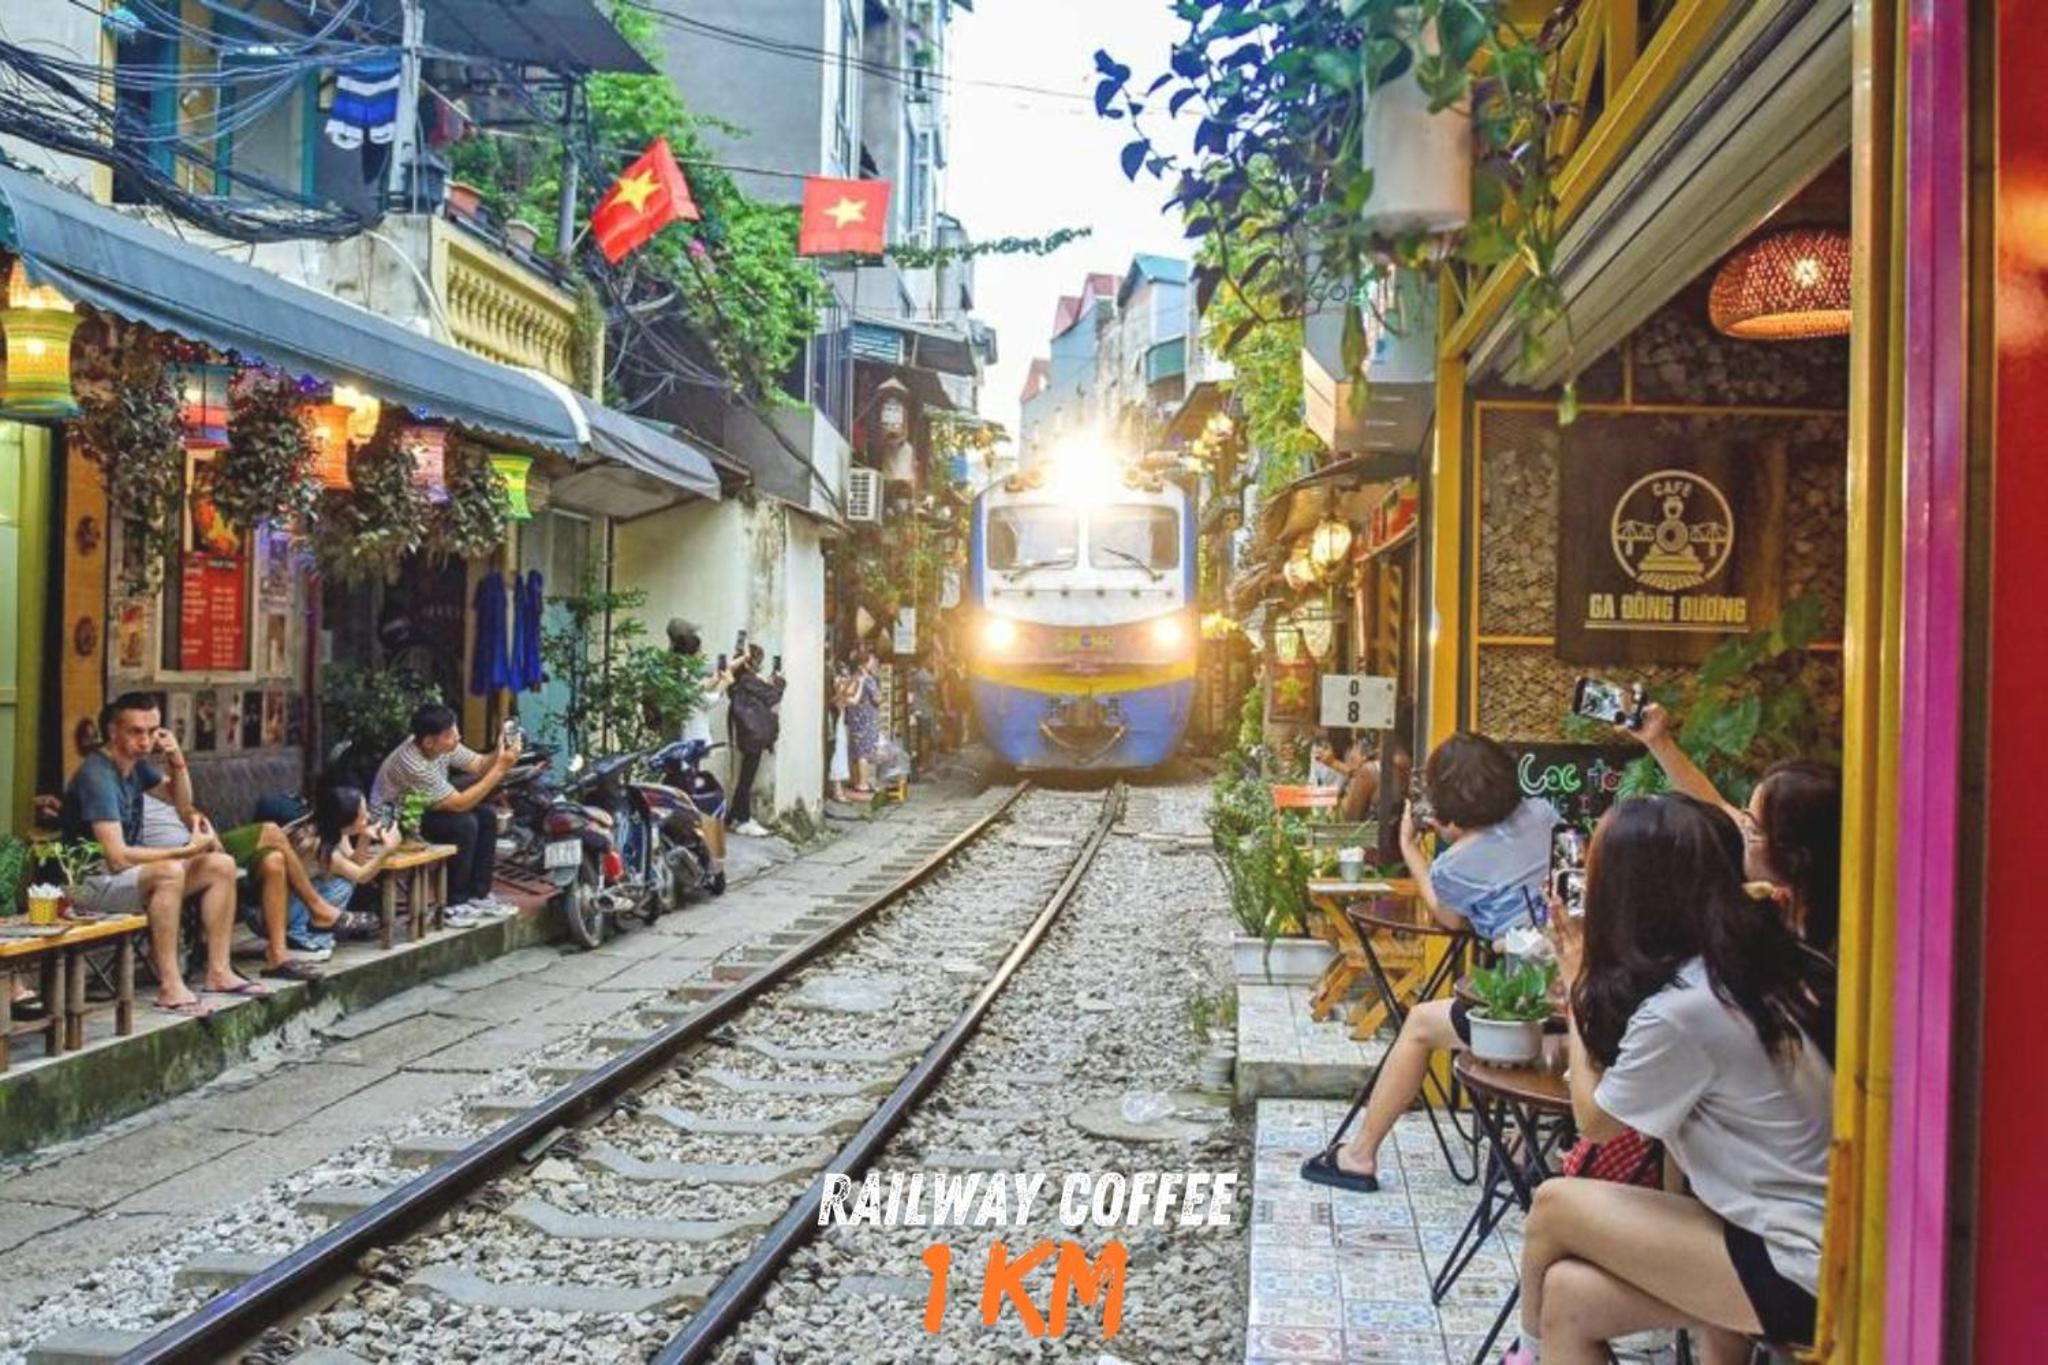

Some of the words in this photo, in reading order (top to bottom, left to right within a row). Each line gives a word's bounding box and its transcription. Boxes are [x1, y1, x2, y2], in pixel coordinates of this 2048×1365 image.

[1652, 480, 1692, 498] CAFE
[1588, 593, 1615, 620] GA
[1620, 590, 1675, 622] ĐÔNG
[1347, 701, 1360, 723] 8
